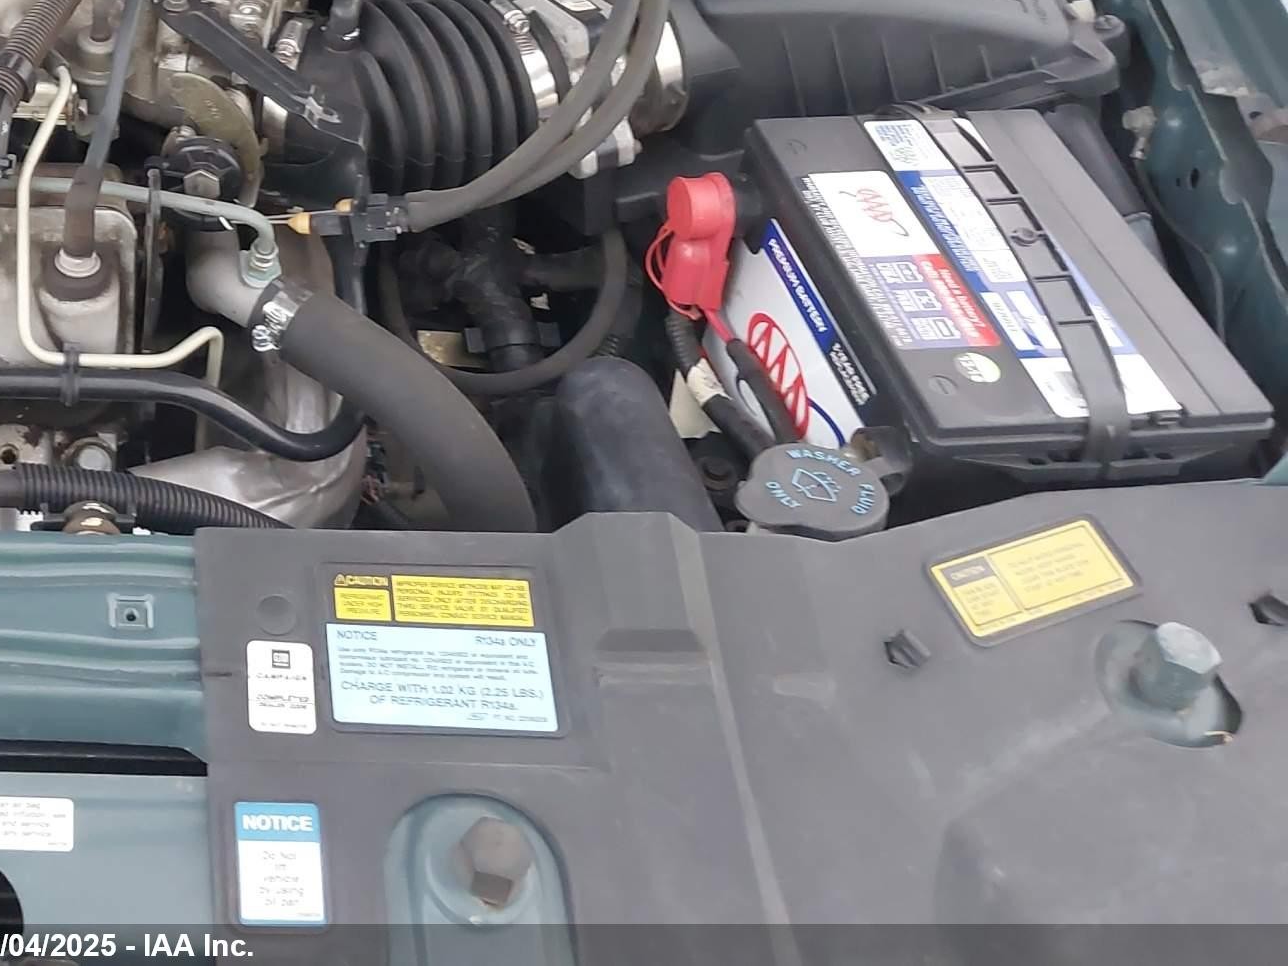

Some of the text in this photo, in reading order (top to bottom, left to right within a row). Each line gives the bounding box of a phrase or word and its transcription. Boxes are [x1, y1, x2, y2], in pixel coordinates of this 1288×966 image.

[768, 238, 801, 288] PREMIUM
[748, 312, 809, 440] AAA
[786, 449, 861, 476] WASHER
[765, 481, 803, 508] ONLY
[850, 483, 876, 514] FLUID
[336, 630, 378, 641] NOTICE
[509, 636, 537, 647] ONLY
[341, 681, 393, 692] CHARGE
[398, 683, 428, 693] WITH
[459, 686, 476, 695] KG
[370, 695, 385, 705] OF
[391, 696, 476, 709] REFRIGERANT
[242, 814, 314, 832] NOTICE
